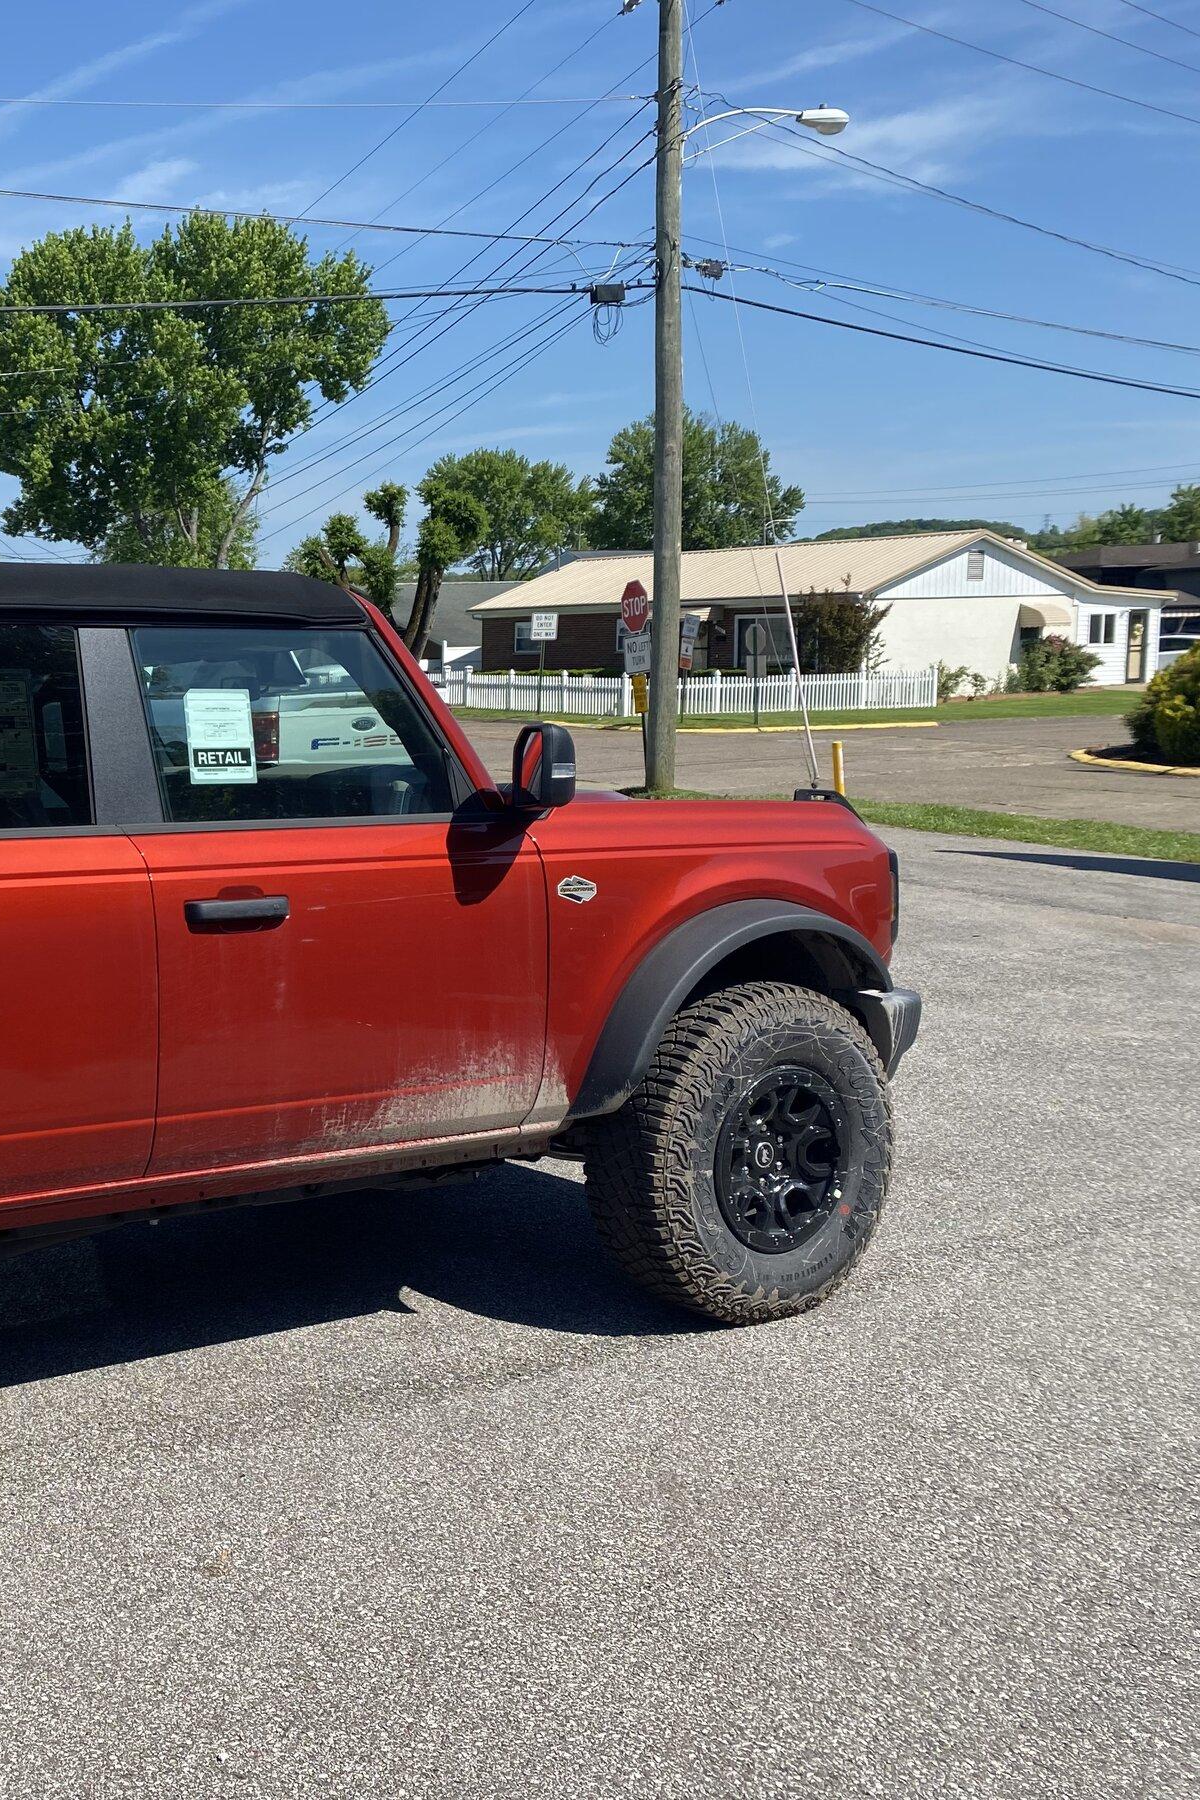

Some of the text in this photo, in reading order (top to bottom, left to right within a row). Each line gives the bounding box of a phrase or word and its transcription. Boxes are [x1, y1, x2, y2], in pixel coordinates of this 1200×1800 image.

[623, 596, 646, 618] STOP
[626, 641, 638, 654] NO
[632, 655, 646, 666] TURN
[197, 751, 247, 765] RETAIL
